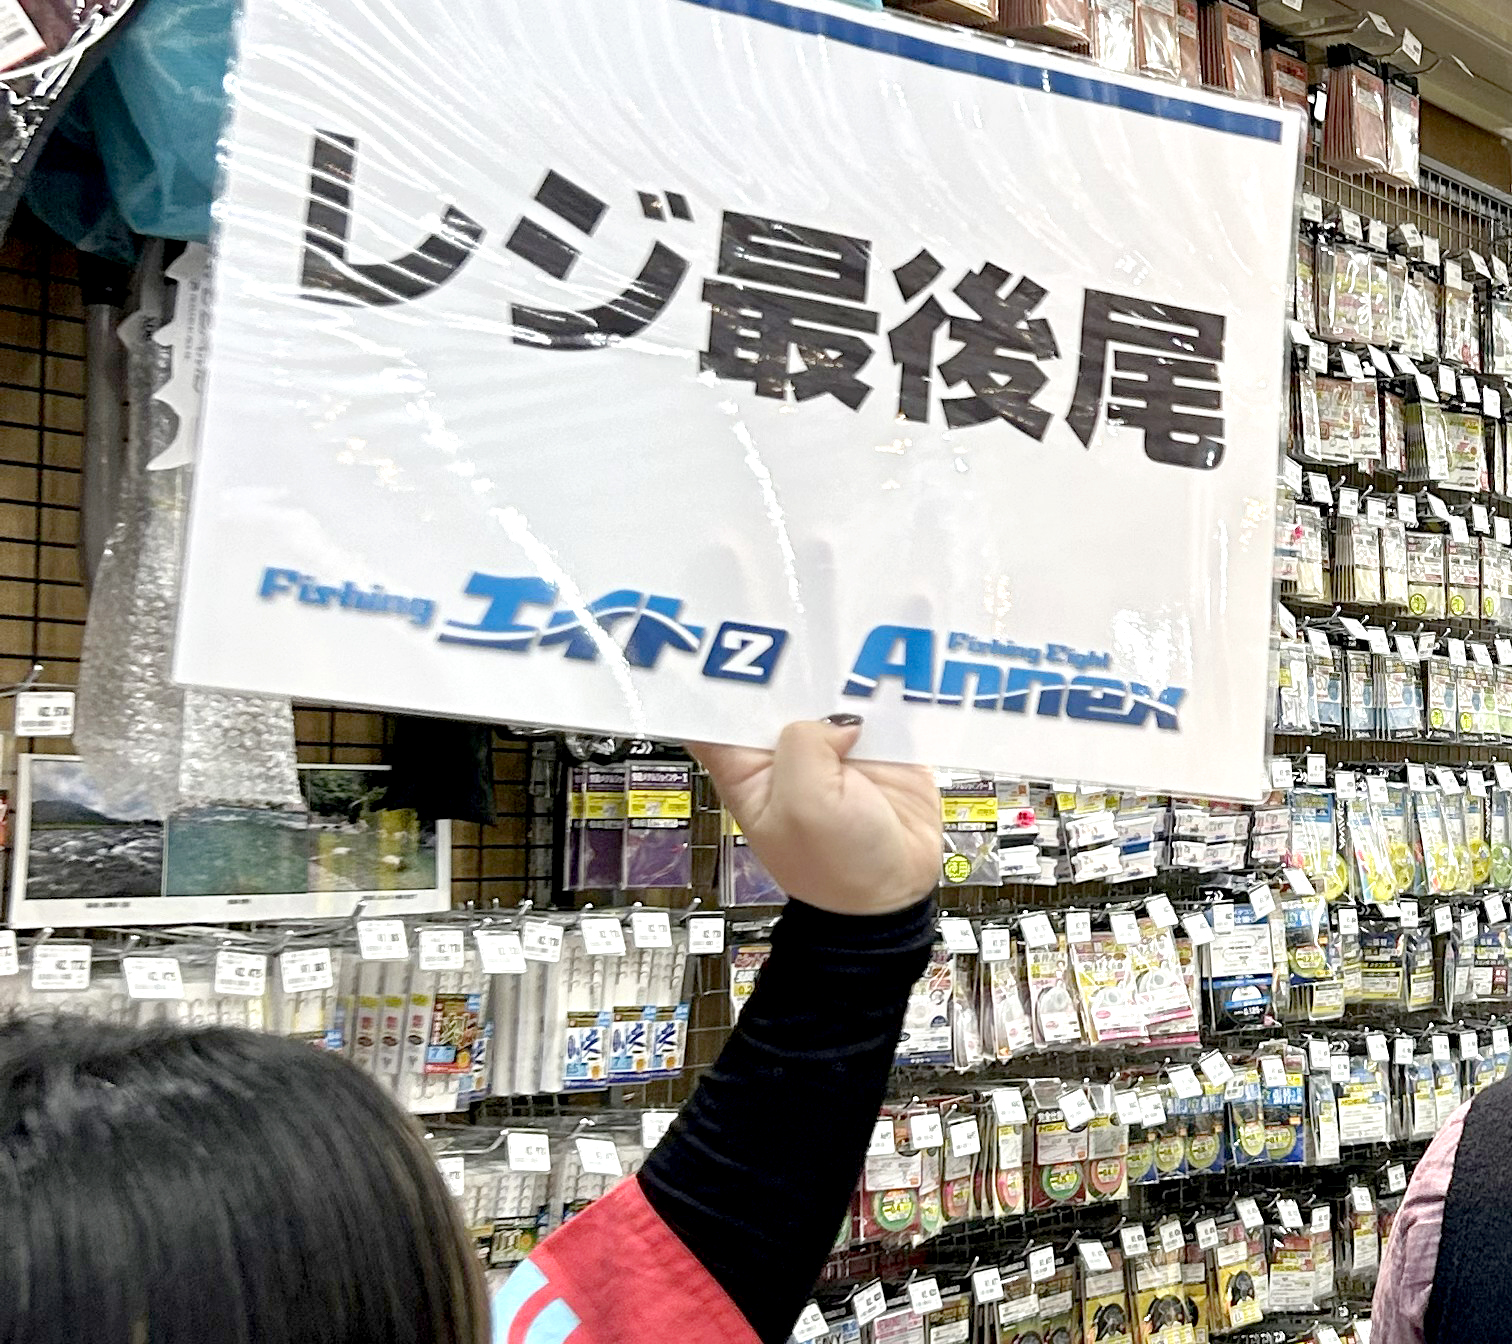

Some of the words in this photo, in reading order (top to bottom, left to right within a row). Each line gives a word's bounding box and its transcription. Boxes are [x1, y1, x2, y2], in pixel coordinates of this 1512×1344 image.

[299, 128, 1229, 472] レジ最後尾
[259, 566, 435, 627] Fishing
[842, 623, 1189, 731] Annex
